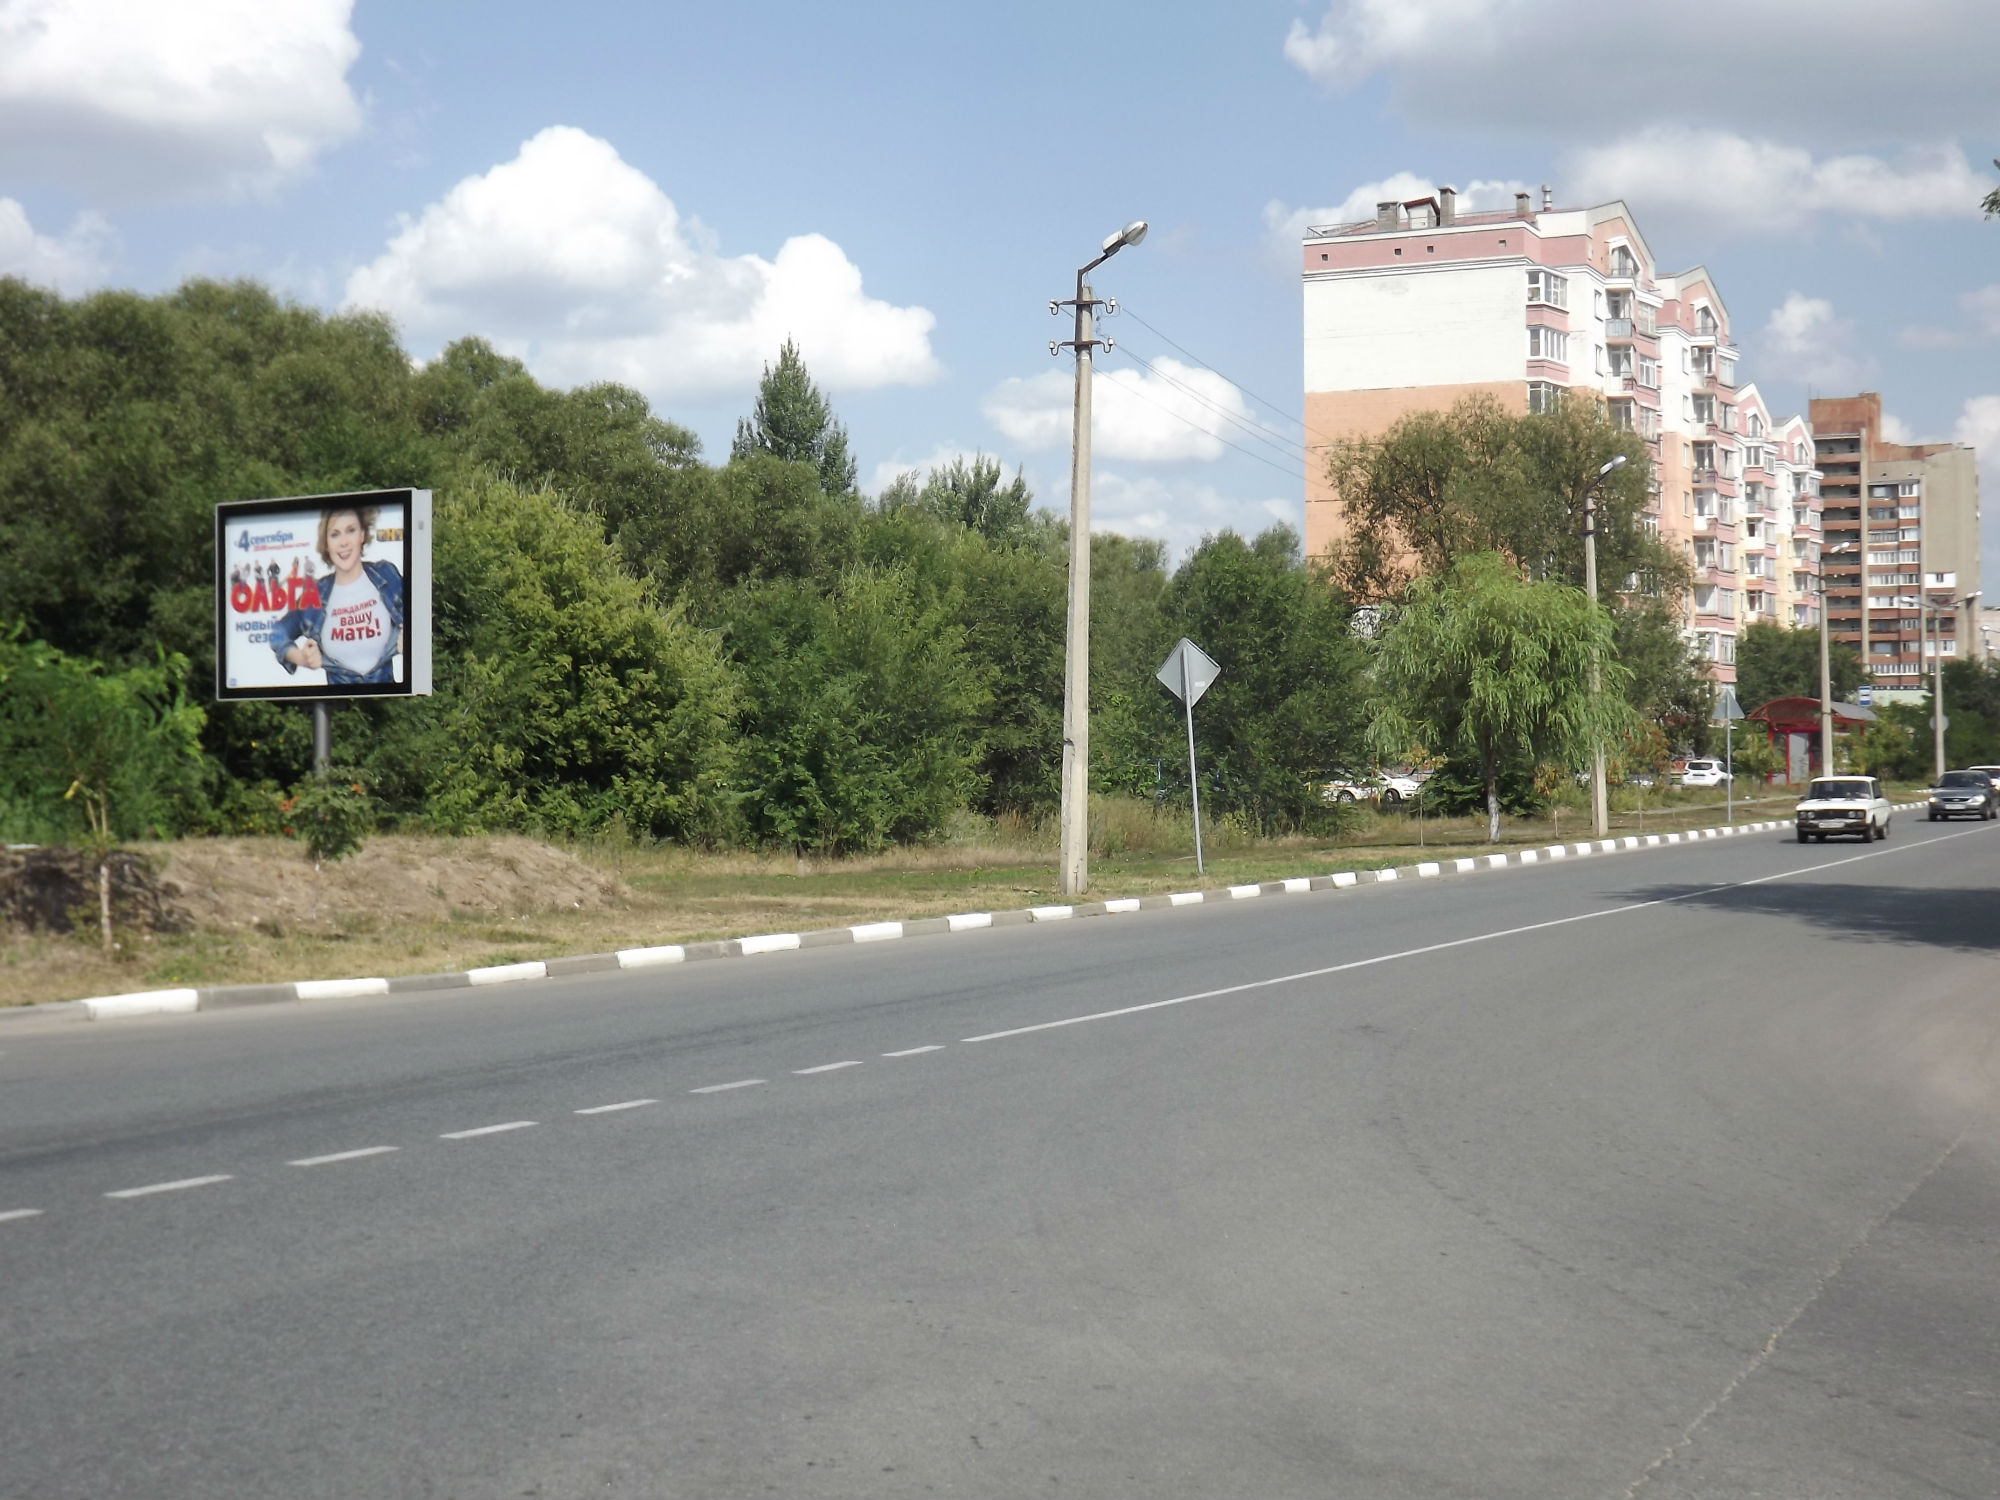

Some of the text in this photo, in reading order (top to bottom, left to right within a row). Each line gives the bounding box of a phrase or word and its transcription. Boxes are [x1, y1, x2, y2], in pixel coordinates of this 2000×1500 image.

[238, 530, 249, 552] 4
[251, 530, 293, 545] сентября
[231, 576, 322, 613] ОЛЬГА
[331, 599, 377, 616] дождались
[340, 611, 372, 626] вашу
[331, 618, 381, 641] мать!
